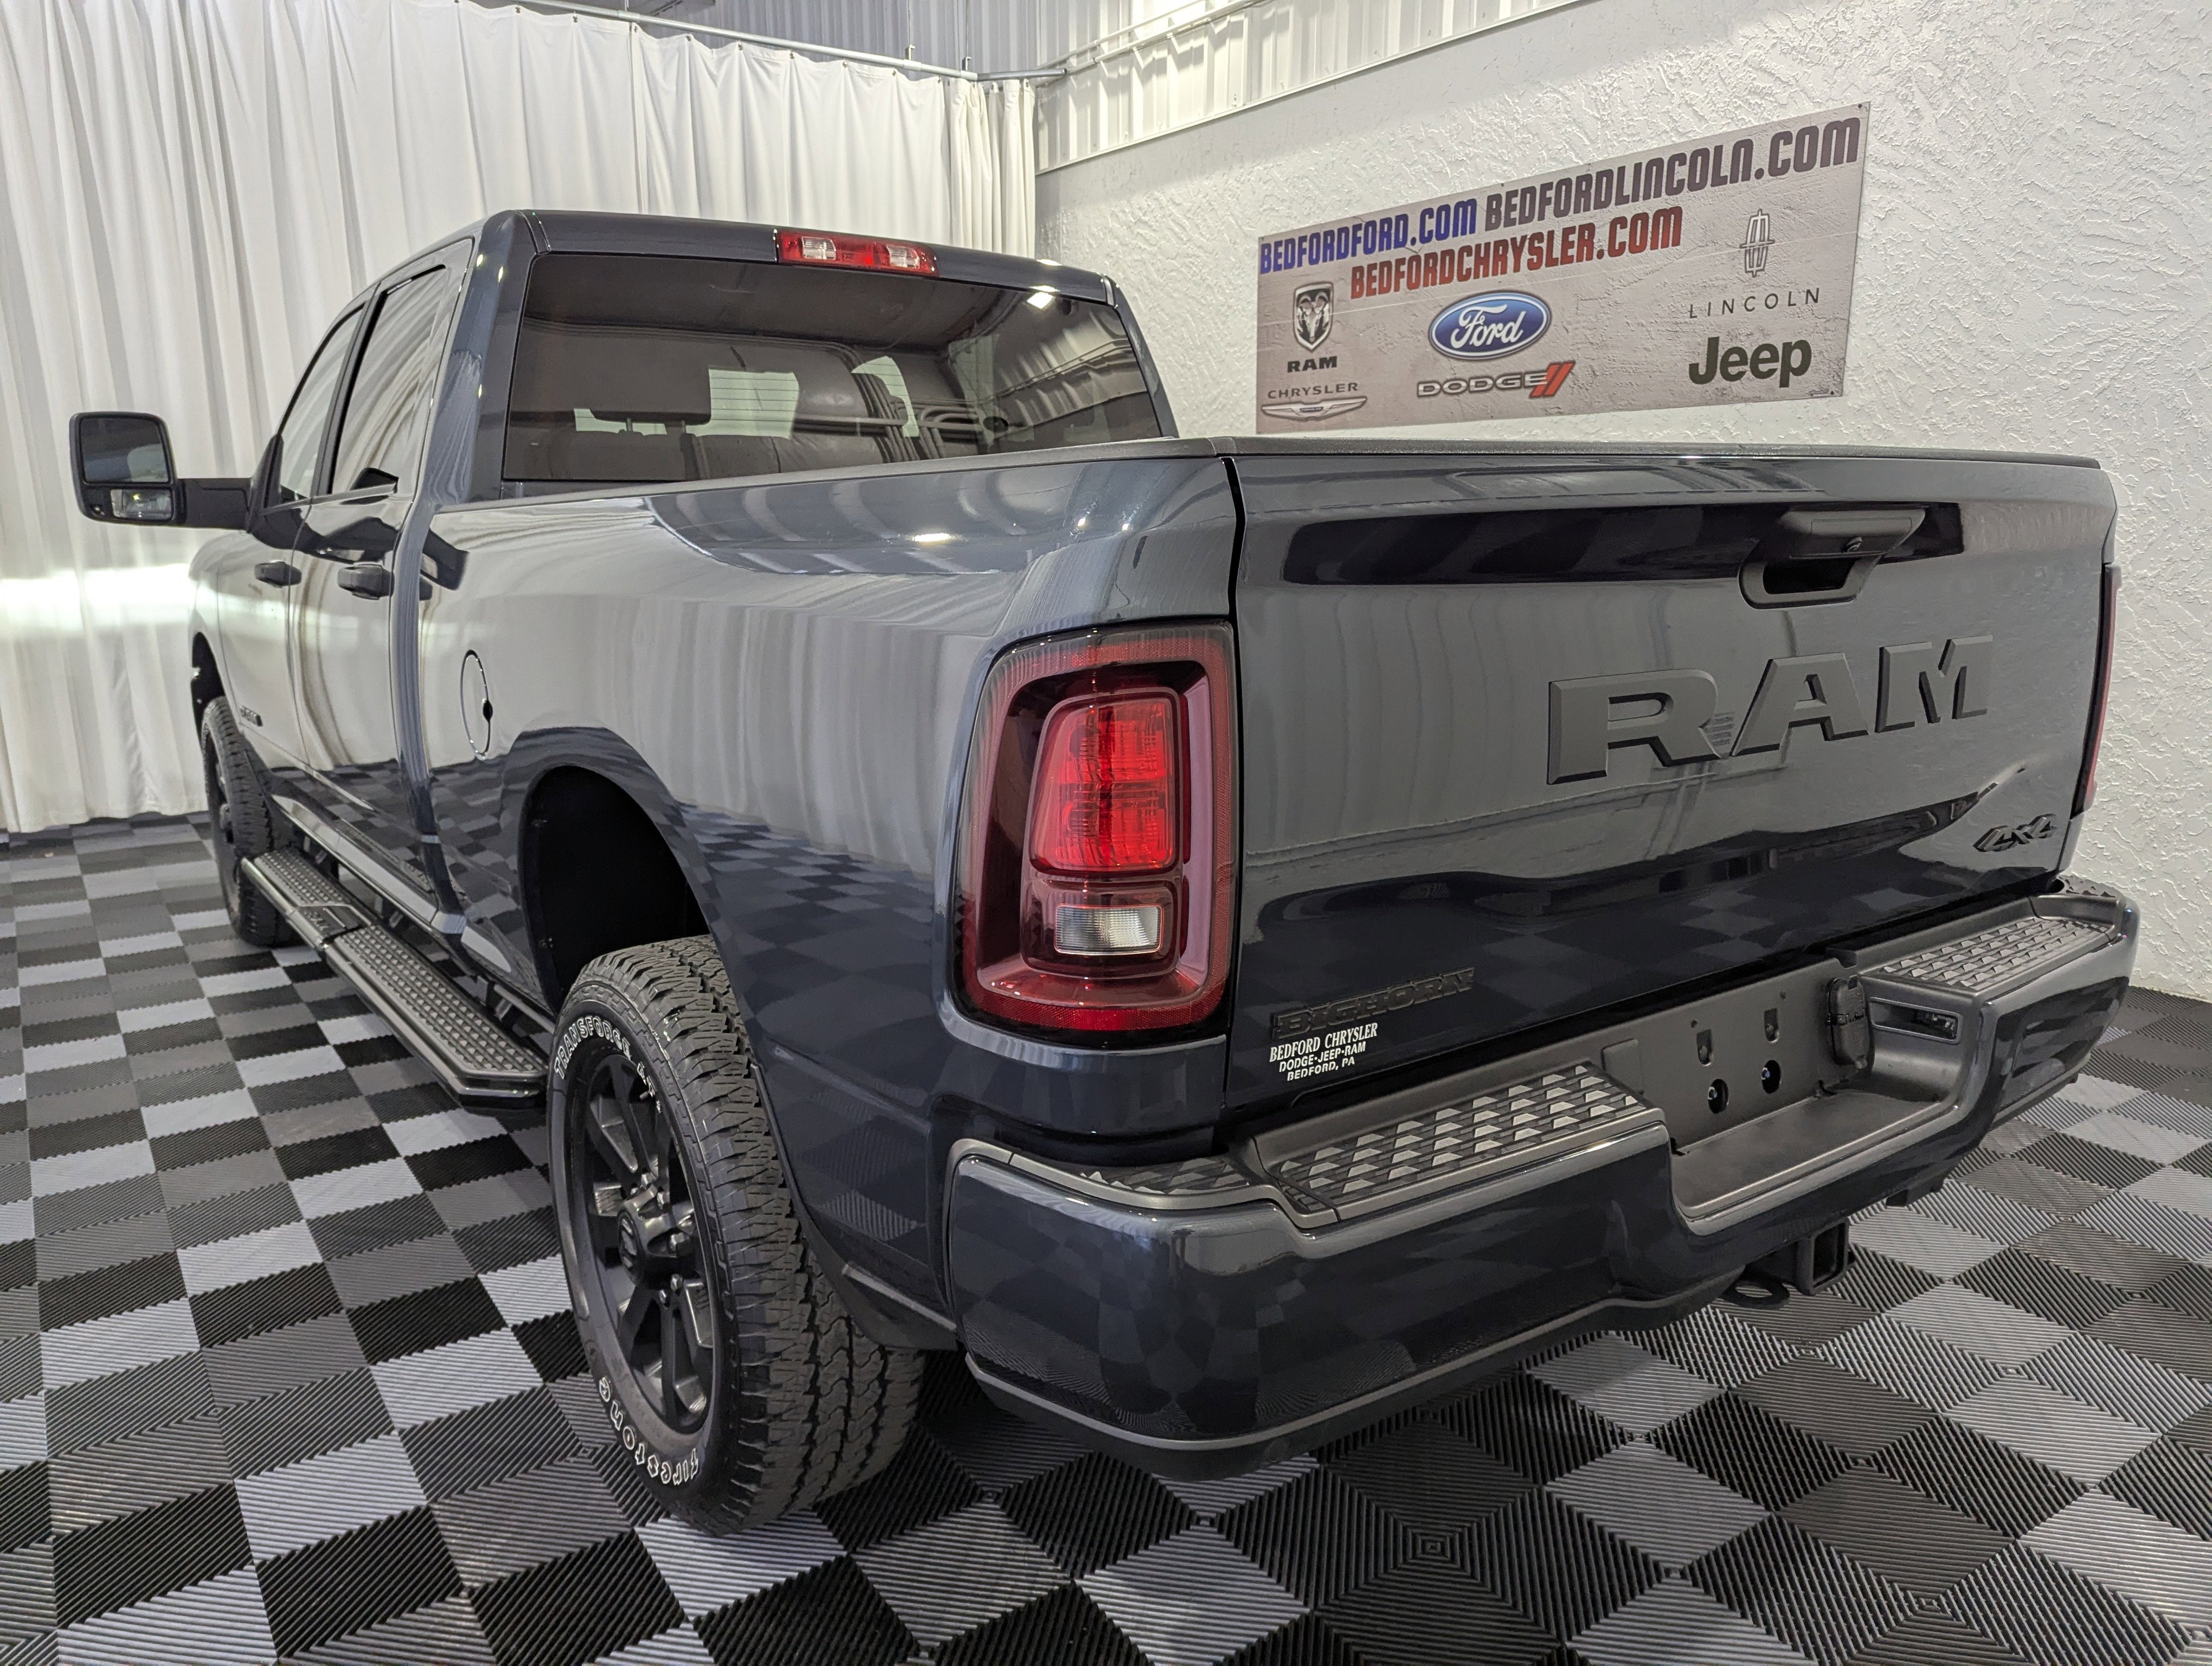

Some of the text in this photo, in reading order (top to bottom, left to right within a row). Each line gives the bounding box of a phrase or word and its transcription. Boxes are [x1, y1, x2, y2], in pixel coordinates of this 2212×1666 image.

[1260, 117, 1861, 274] BEDFORDFORD.COM BEDFORDLINCOLN.COM
[1351, 206, 1683, 300] BEDFORDCHRYSLER.COM
[1689, 287, 1820, 319] LINCOLN
[1450, 304, 1527, 349] Ford
[1287, 356, 1338, 373] RAM
[1417, 371, 1549, 398] DODGE
[1689, 336, 1812, 388] Jeep
[1268, 382, 1359, 399] CHRYSLER
[1546, 634, 1993, 785] RAM
[554, 1015, 632, 1080] TRANSFORCE
[1269, 1022, 1378, 1062] BEDFORD CHRYSLER
[1287, 1056, 1355, 1081] BEDFORD, PA
[599, 1375, 699, 1486] Firestone
